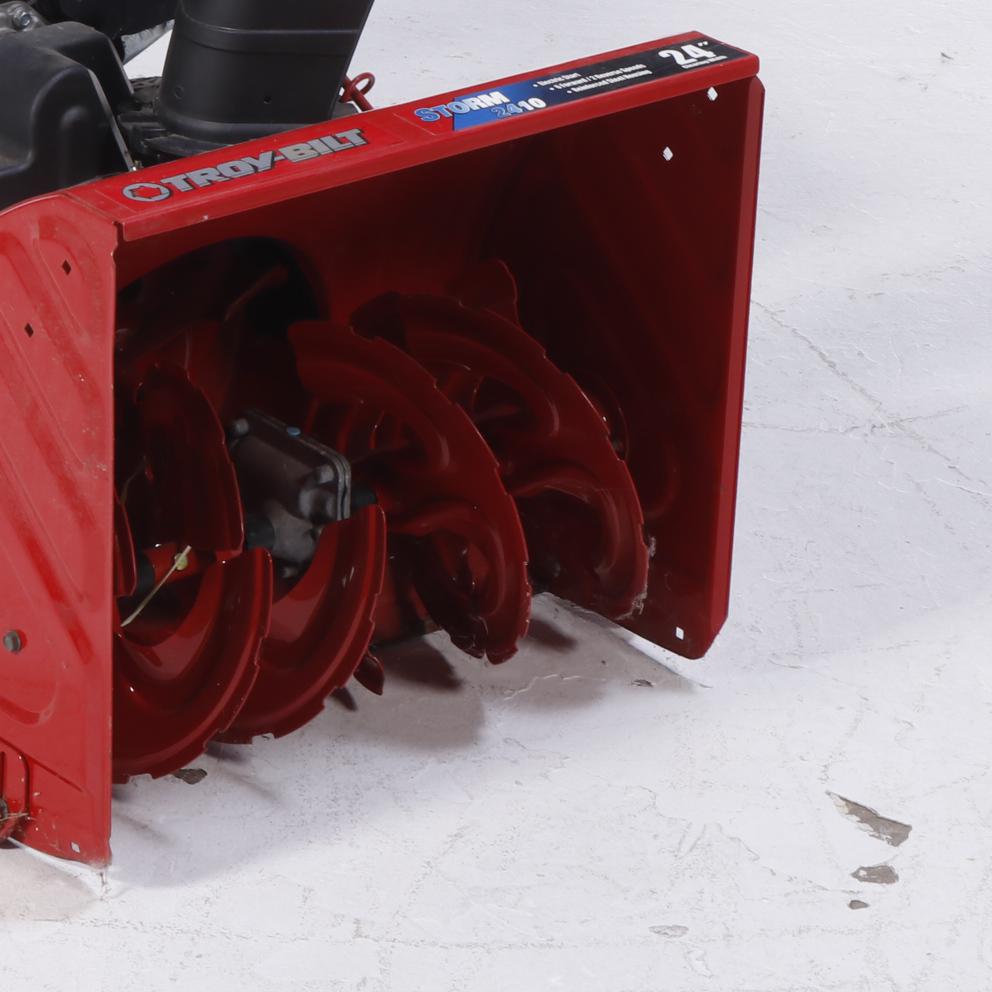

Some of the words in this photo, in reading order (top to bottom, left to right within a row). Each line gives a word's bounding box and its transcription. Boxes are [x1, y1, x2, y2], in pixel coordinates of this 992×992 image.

[414, 90, 512, 122] STORM
[491, 97, 548, 119] 2410
[160, 127, 369, 193] TROY-BILT
